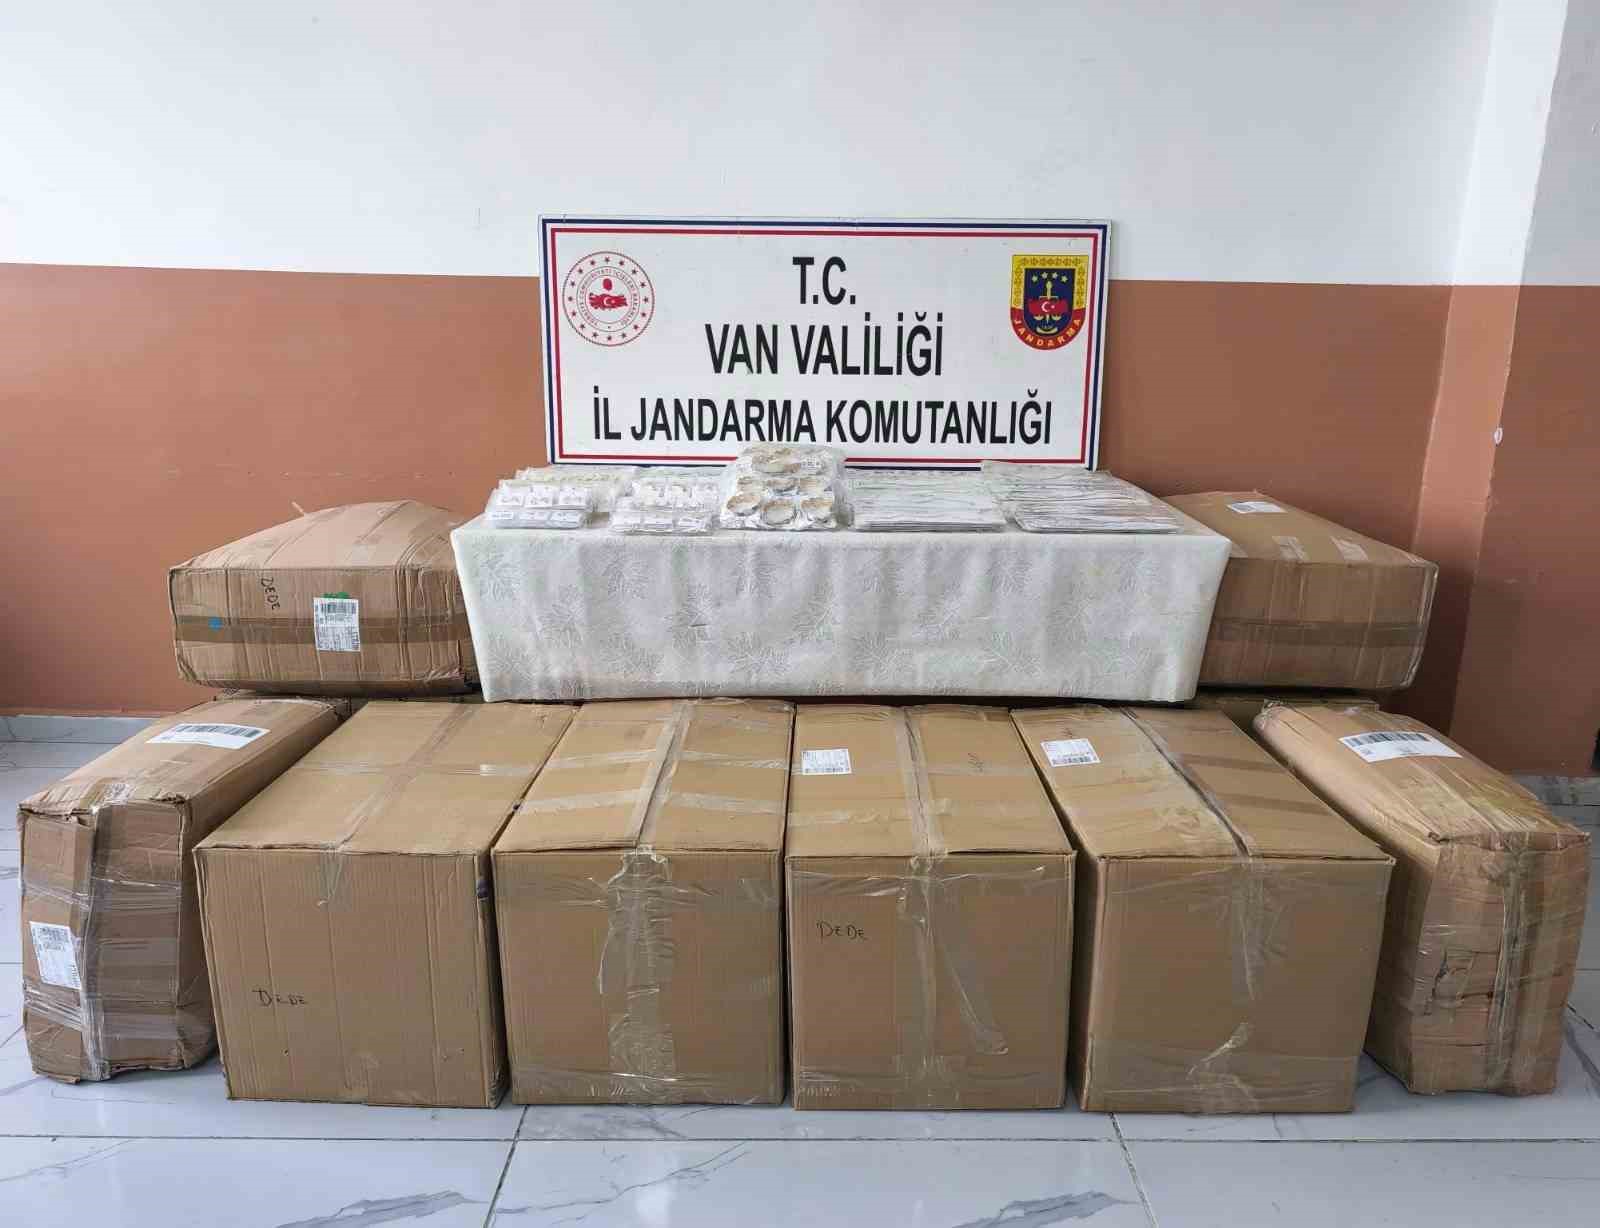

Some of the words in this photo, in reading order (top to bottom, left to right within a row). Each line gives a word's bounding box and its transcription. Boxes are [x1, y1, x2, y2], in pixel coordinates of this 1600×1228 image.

[793, 257, 856, 306] T.C.
[705, 324, 778, 375] VAN
[790, 311, 943, 377] VALİLİĞİ
[1013, 318, 1081, 347] JANDARMA
[593, 385, 622, 441] İL
[630, 397, 817, 444] JANDARMA
[827, 388, 1052, 446] KOMUTANLIĞI
[261, 577, 281, 611] DEDE
